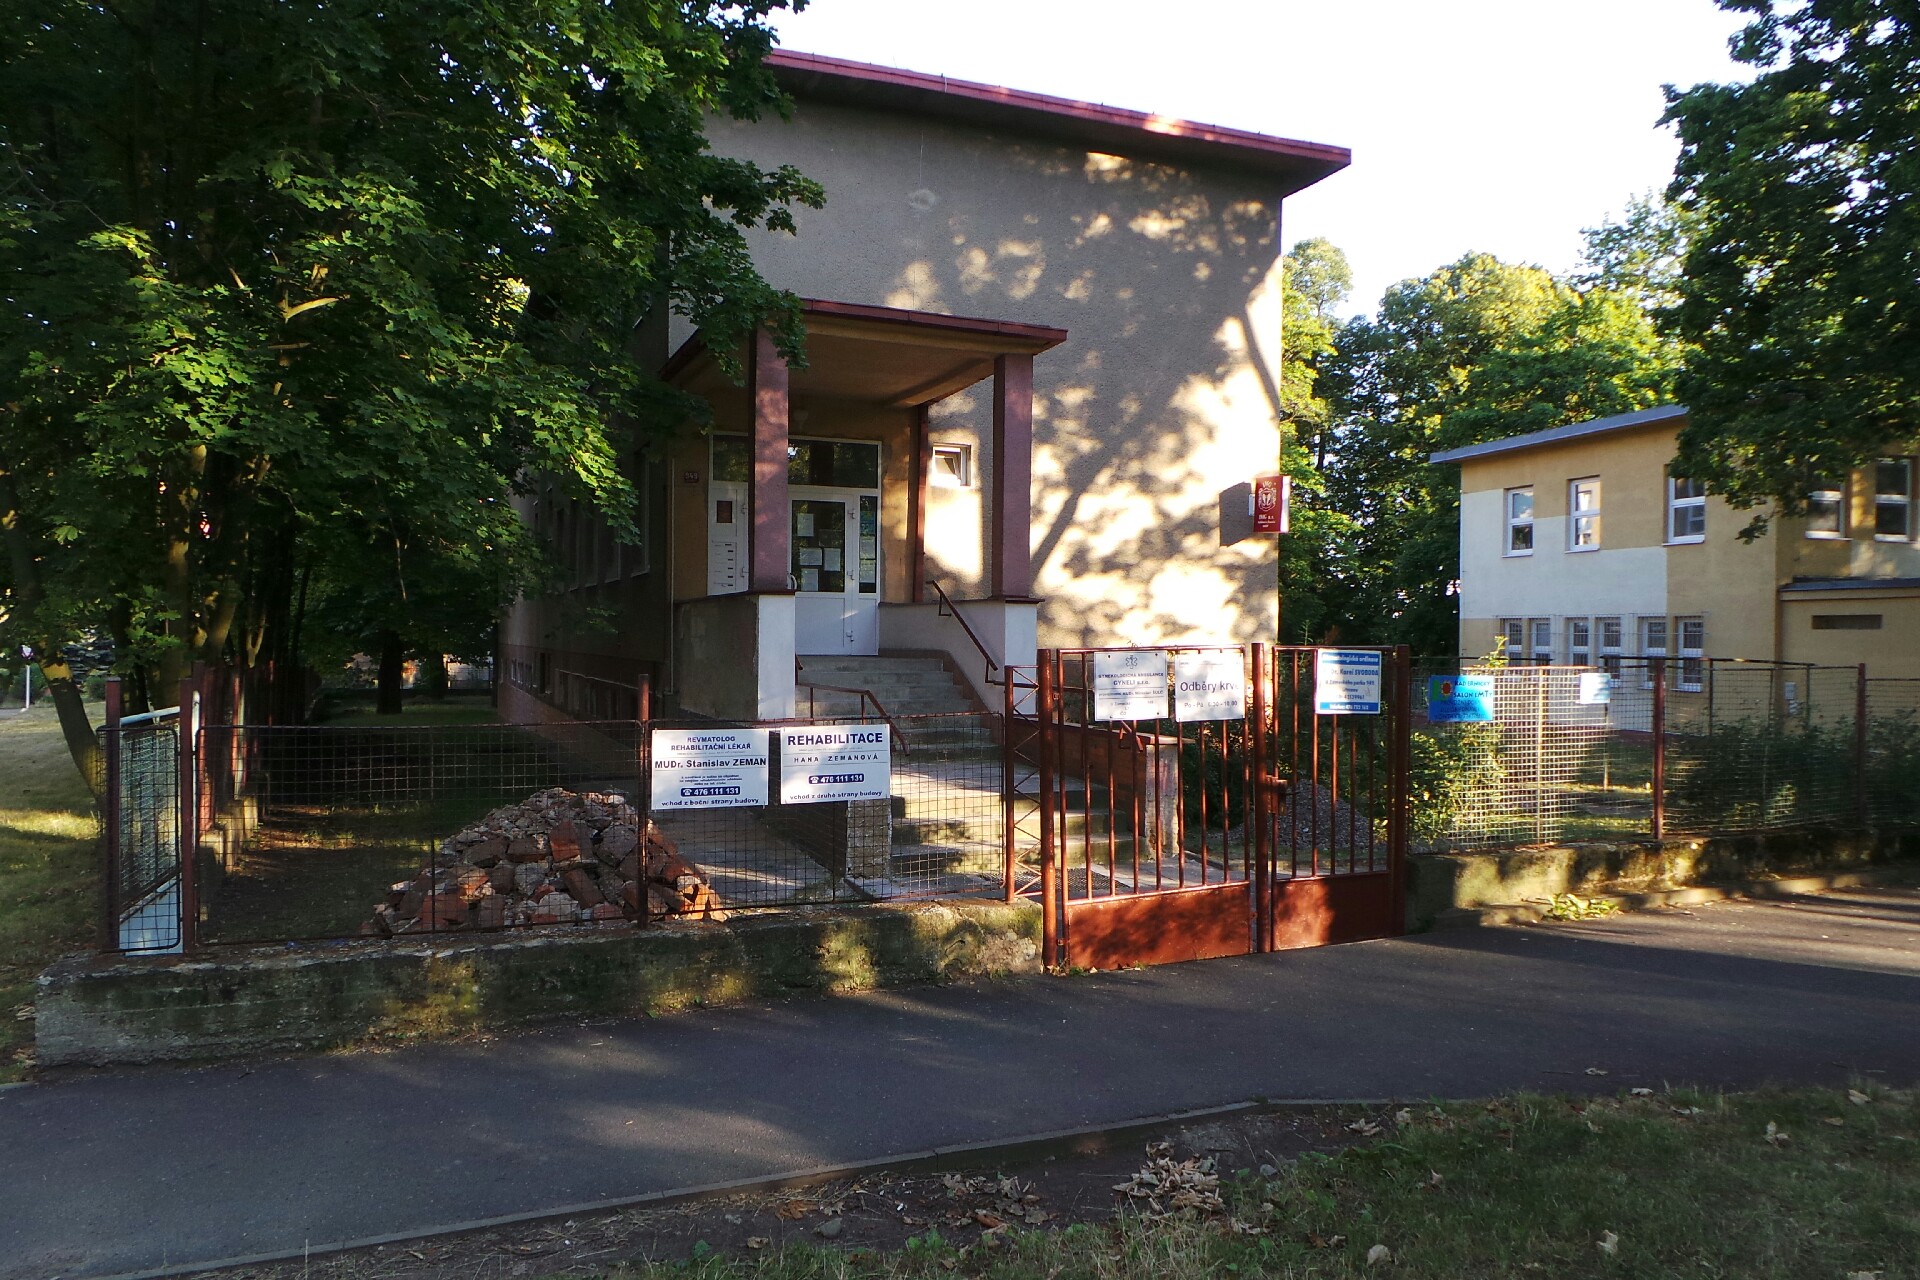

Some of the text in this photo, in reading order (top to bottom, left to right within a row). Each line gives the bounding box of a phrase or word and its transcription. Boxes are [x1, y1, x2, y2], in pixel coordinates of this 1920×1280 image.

[1180, 681, 1217, 694] Odběry
[787, 732, 883, 746] REHABILITACE
[671, 743, 726, 751] REHABILITAČNÍ
[827, 753, 879, 762] ZEMANOVÁ
[654, 758, 767, 769] MUDr. Stanislav ZEMAN
[693, 787, 739, 796] 476 111 131
[837, 791, 859, 799] strany
[711, 798, 733, 806] strany
[734, 797, 759, 805] budovy
